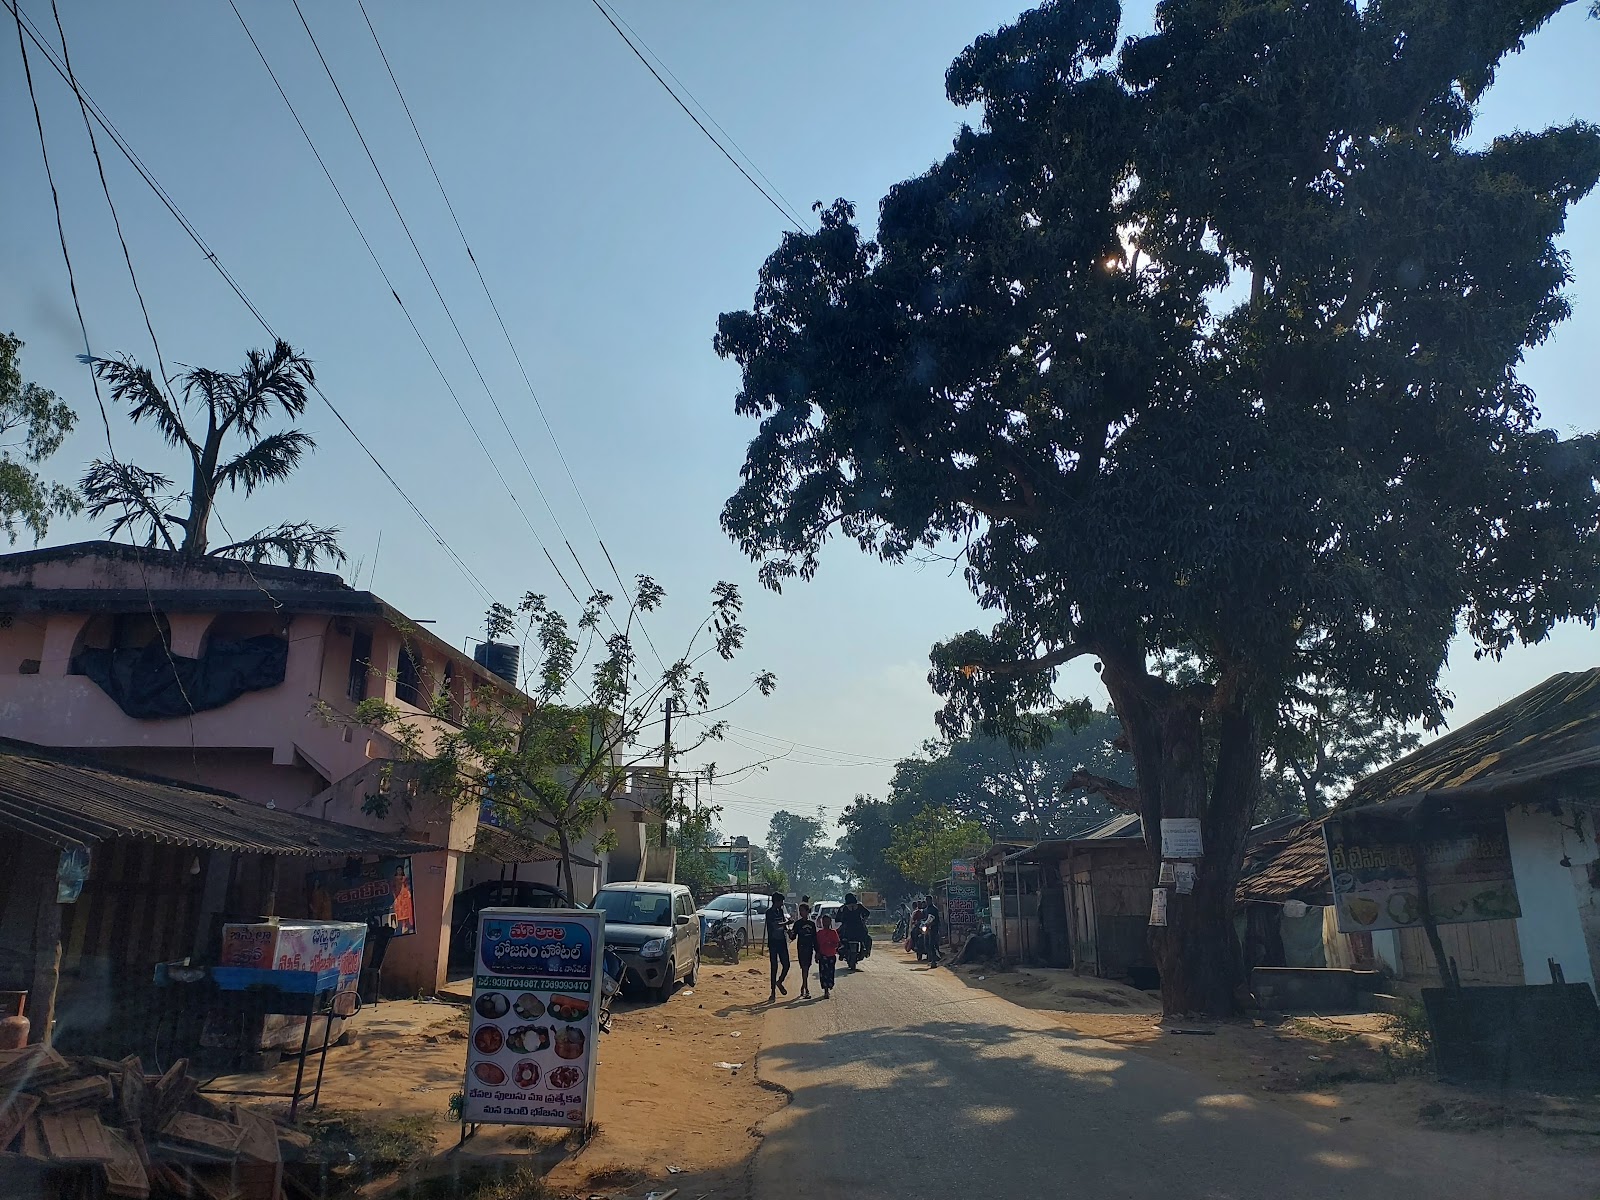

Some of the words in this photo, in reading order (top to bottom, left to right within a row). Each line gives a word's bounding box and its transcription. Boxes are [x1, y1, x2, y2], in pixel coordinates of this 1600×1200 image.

[494, 940, 539, 959] భోజనం
[540, 942, 583, 960] హోటల్
[469, 1088, 493, 1099] చేపల
[494, 1090, 526, 1101] పులుసు
[528, 1092, 543, 1102] మా
[544, 1093, 582, 1106] ప్రత్యేకత
[483, 1105, 502, 1114] మన
[503, 1106, 529, 1116] ఇంటి
[530, 1107, 565, 1118] భోజనం
